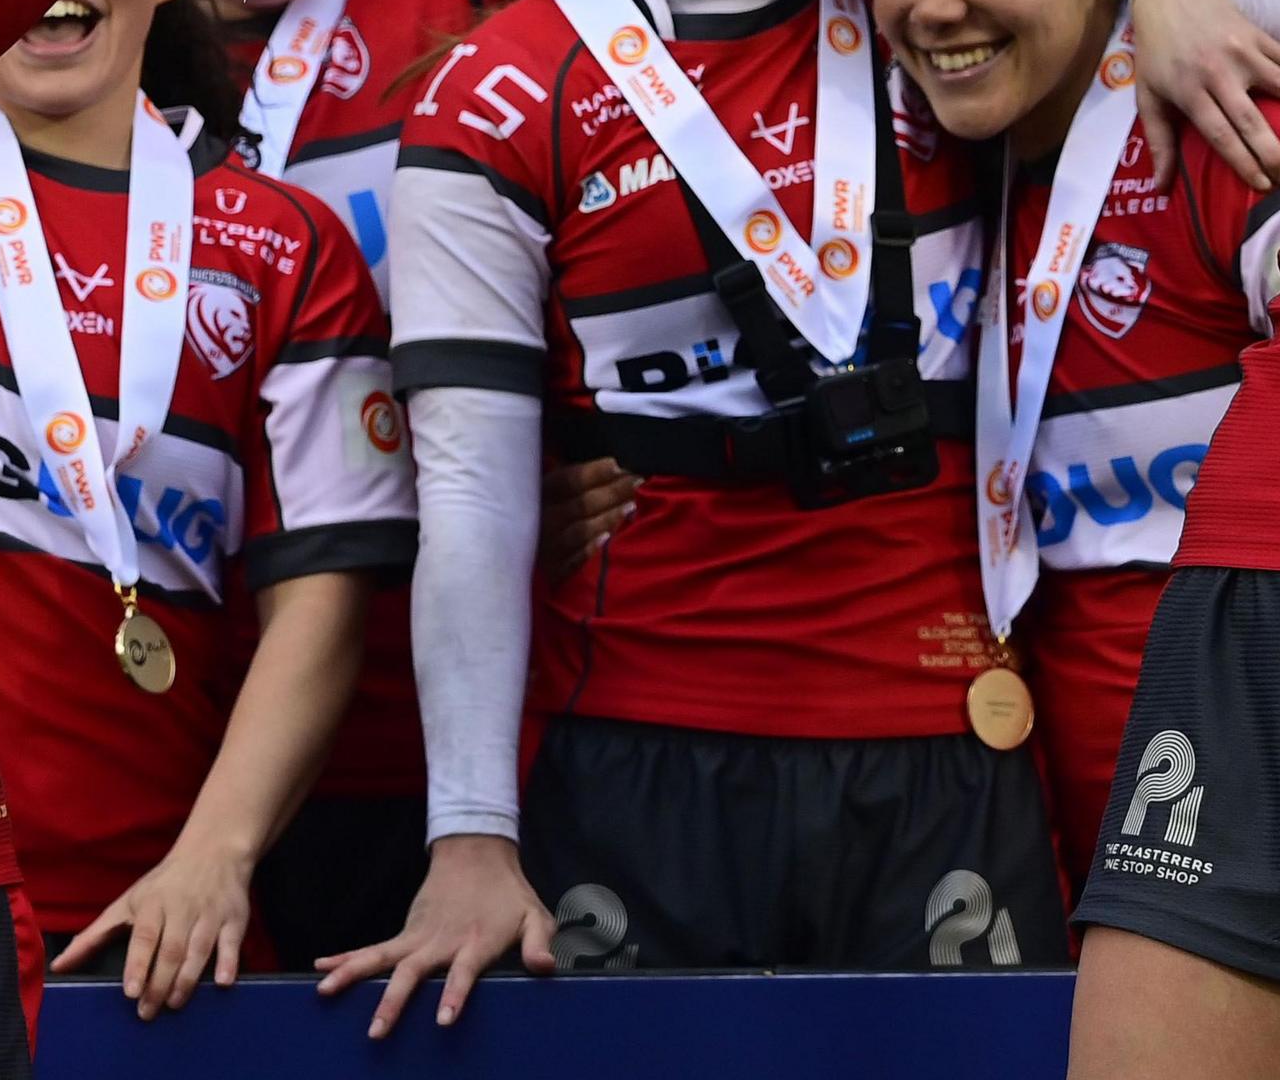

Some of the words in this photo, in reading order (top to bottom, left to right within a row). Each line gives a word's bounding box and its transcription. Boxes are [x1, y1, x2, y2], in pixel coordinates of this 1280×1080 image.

[834, 178, 852, 233] PWR
[8, 240, 33, 288] PWR
[200, 227, 296, 275] LLEGE
[779, 251, 815, 297] PWR
[68, 310, 114, 337] XEN
[70, 459, 96, 512] PWR
[1120, 843, 1213, 875] PLASTERERS
[1121, 860, 1154, 875] STOP
[1156, 866, 1200, 886] SHOP
